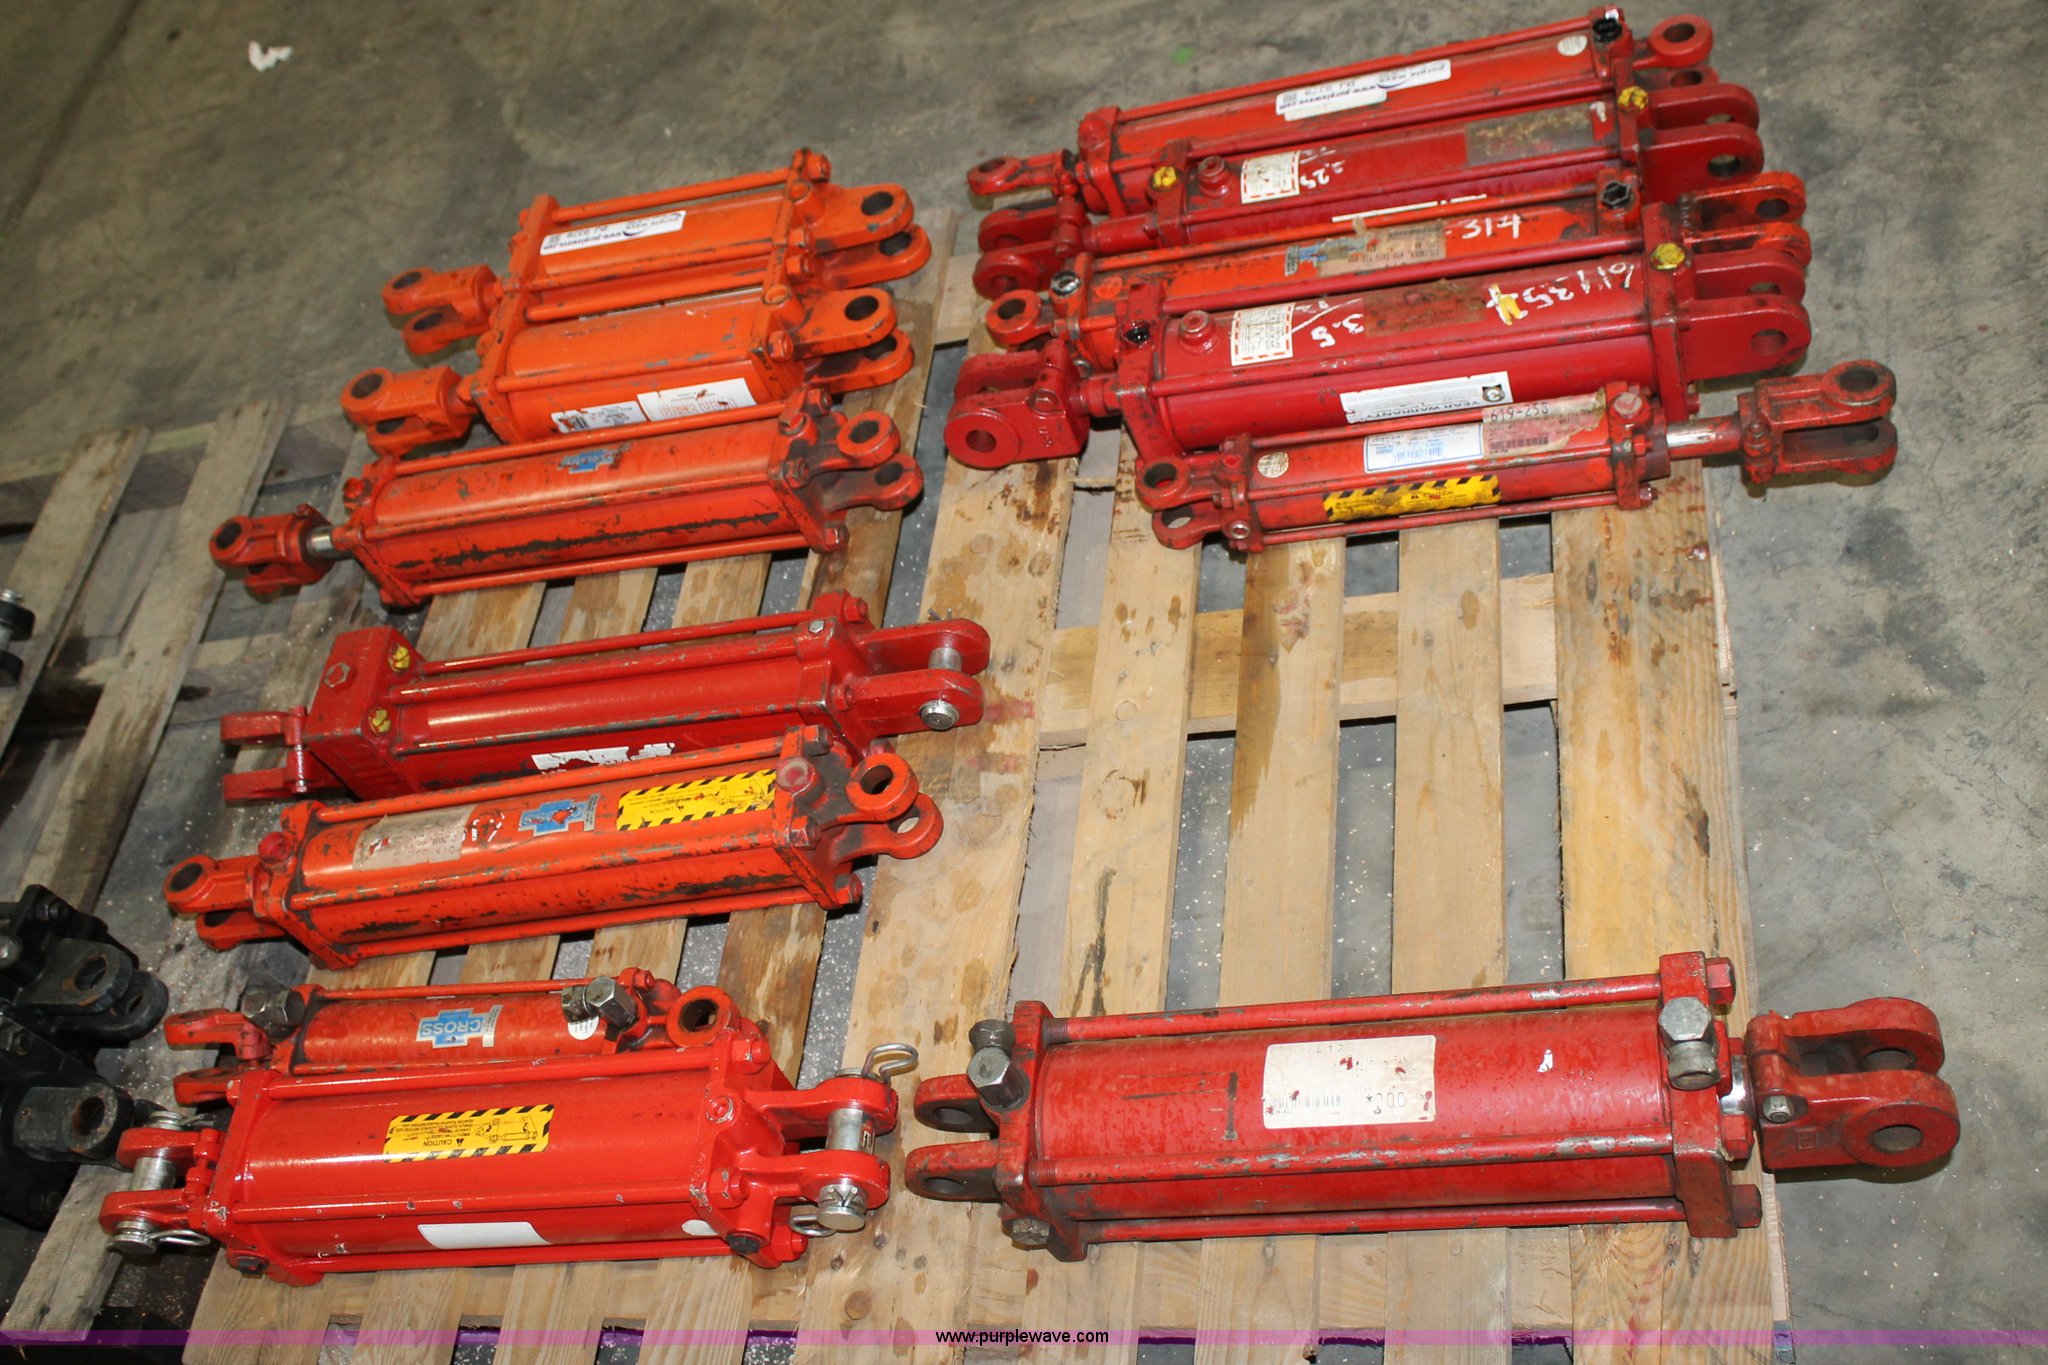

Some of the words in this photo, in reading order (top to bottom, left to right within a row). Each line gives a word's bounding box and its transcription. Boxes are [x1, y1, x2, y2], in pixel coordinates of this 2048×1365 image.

[1444, 400, 1479, 409] YEAR
[1366, 406, 1440, 419] WARRANTY
[649, 806, 674, 815] CAUTION
[421, 1019, 481, 1036] CROSS
